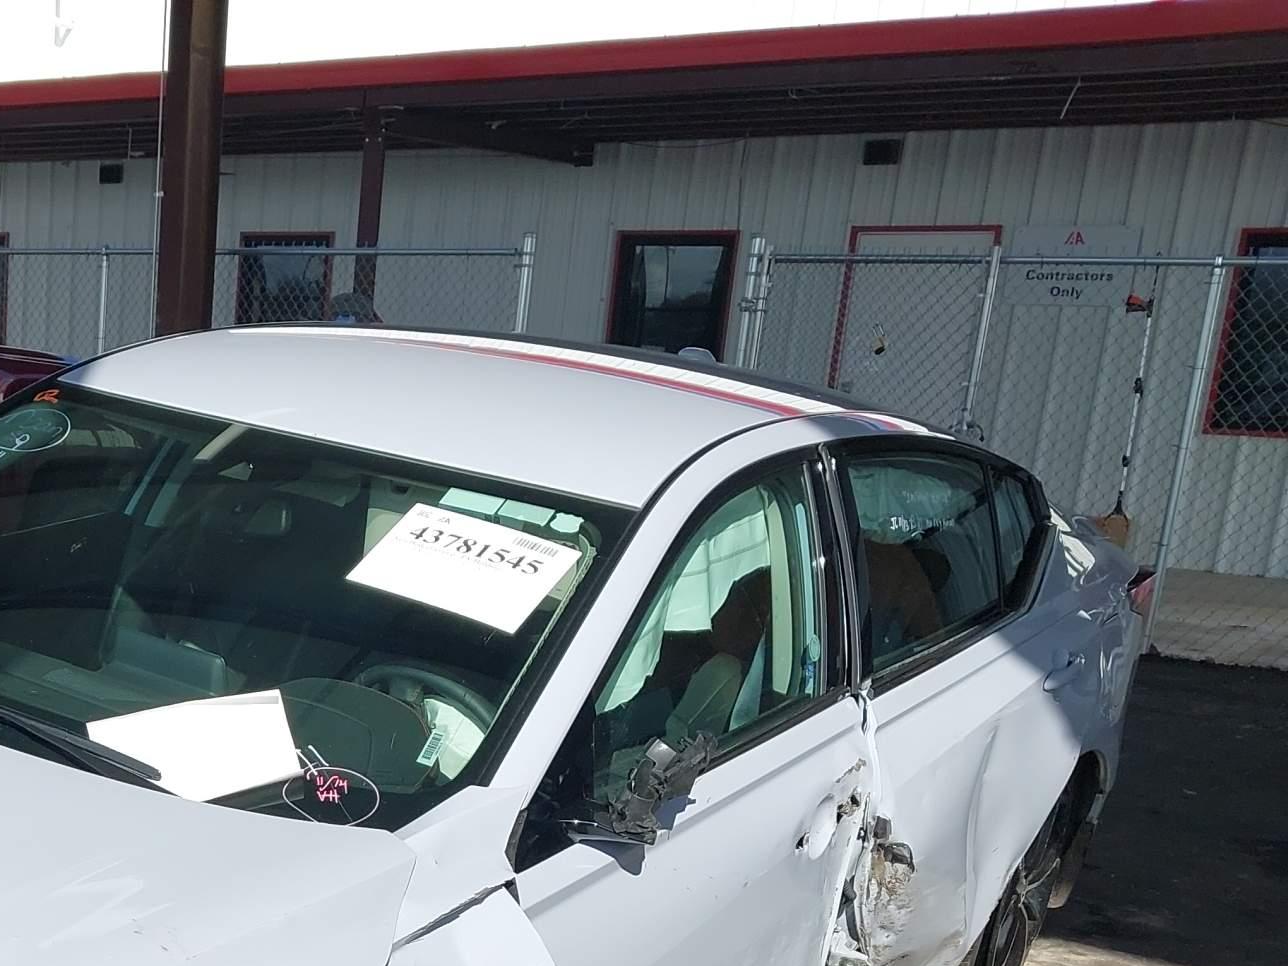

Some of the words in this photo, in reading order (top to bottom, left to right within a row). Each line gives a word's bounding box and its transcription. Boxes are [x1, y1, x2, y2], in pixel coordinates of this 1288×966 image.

[1025, 268, 1114, 282] Contractors
[1049, 285, 1084, 300] Only
[409, 525, 545, 575] 43781545
